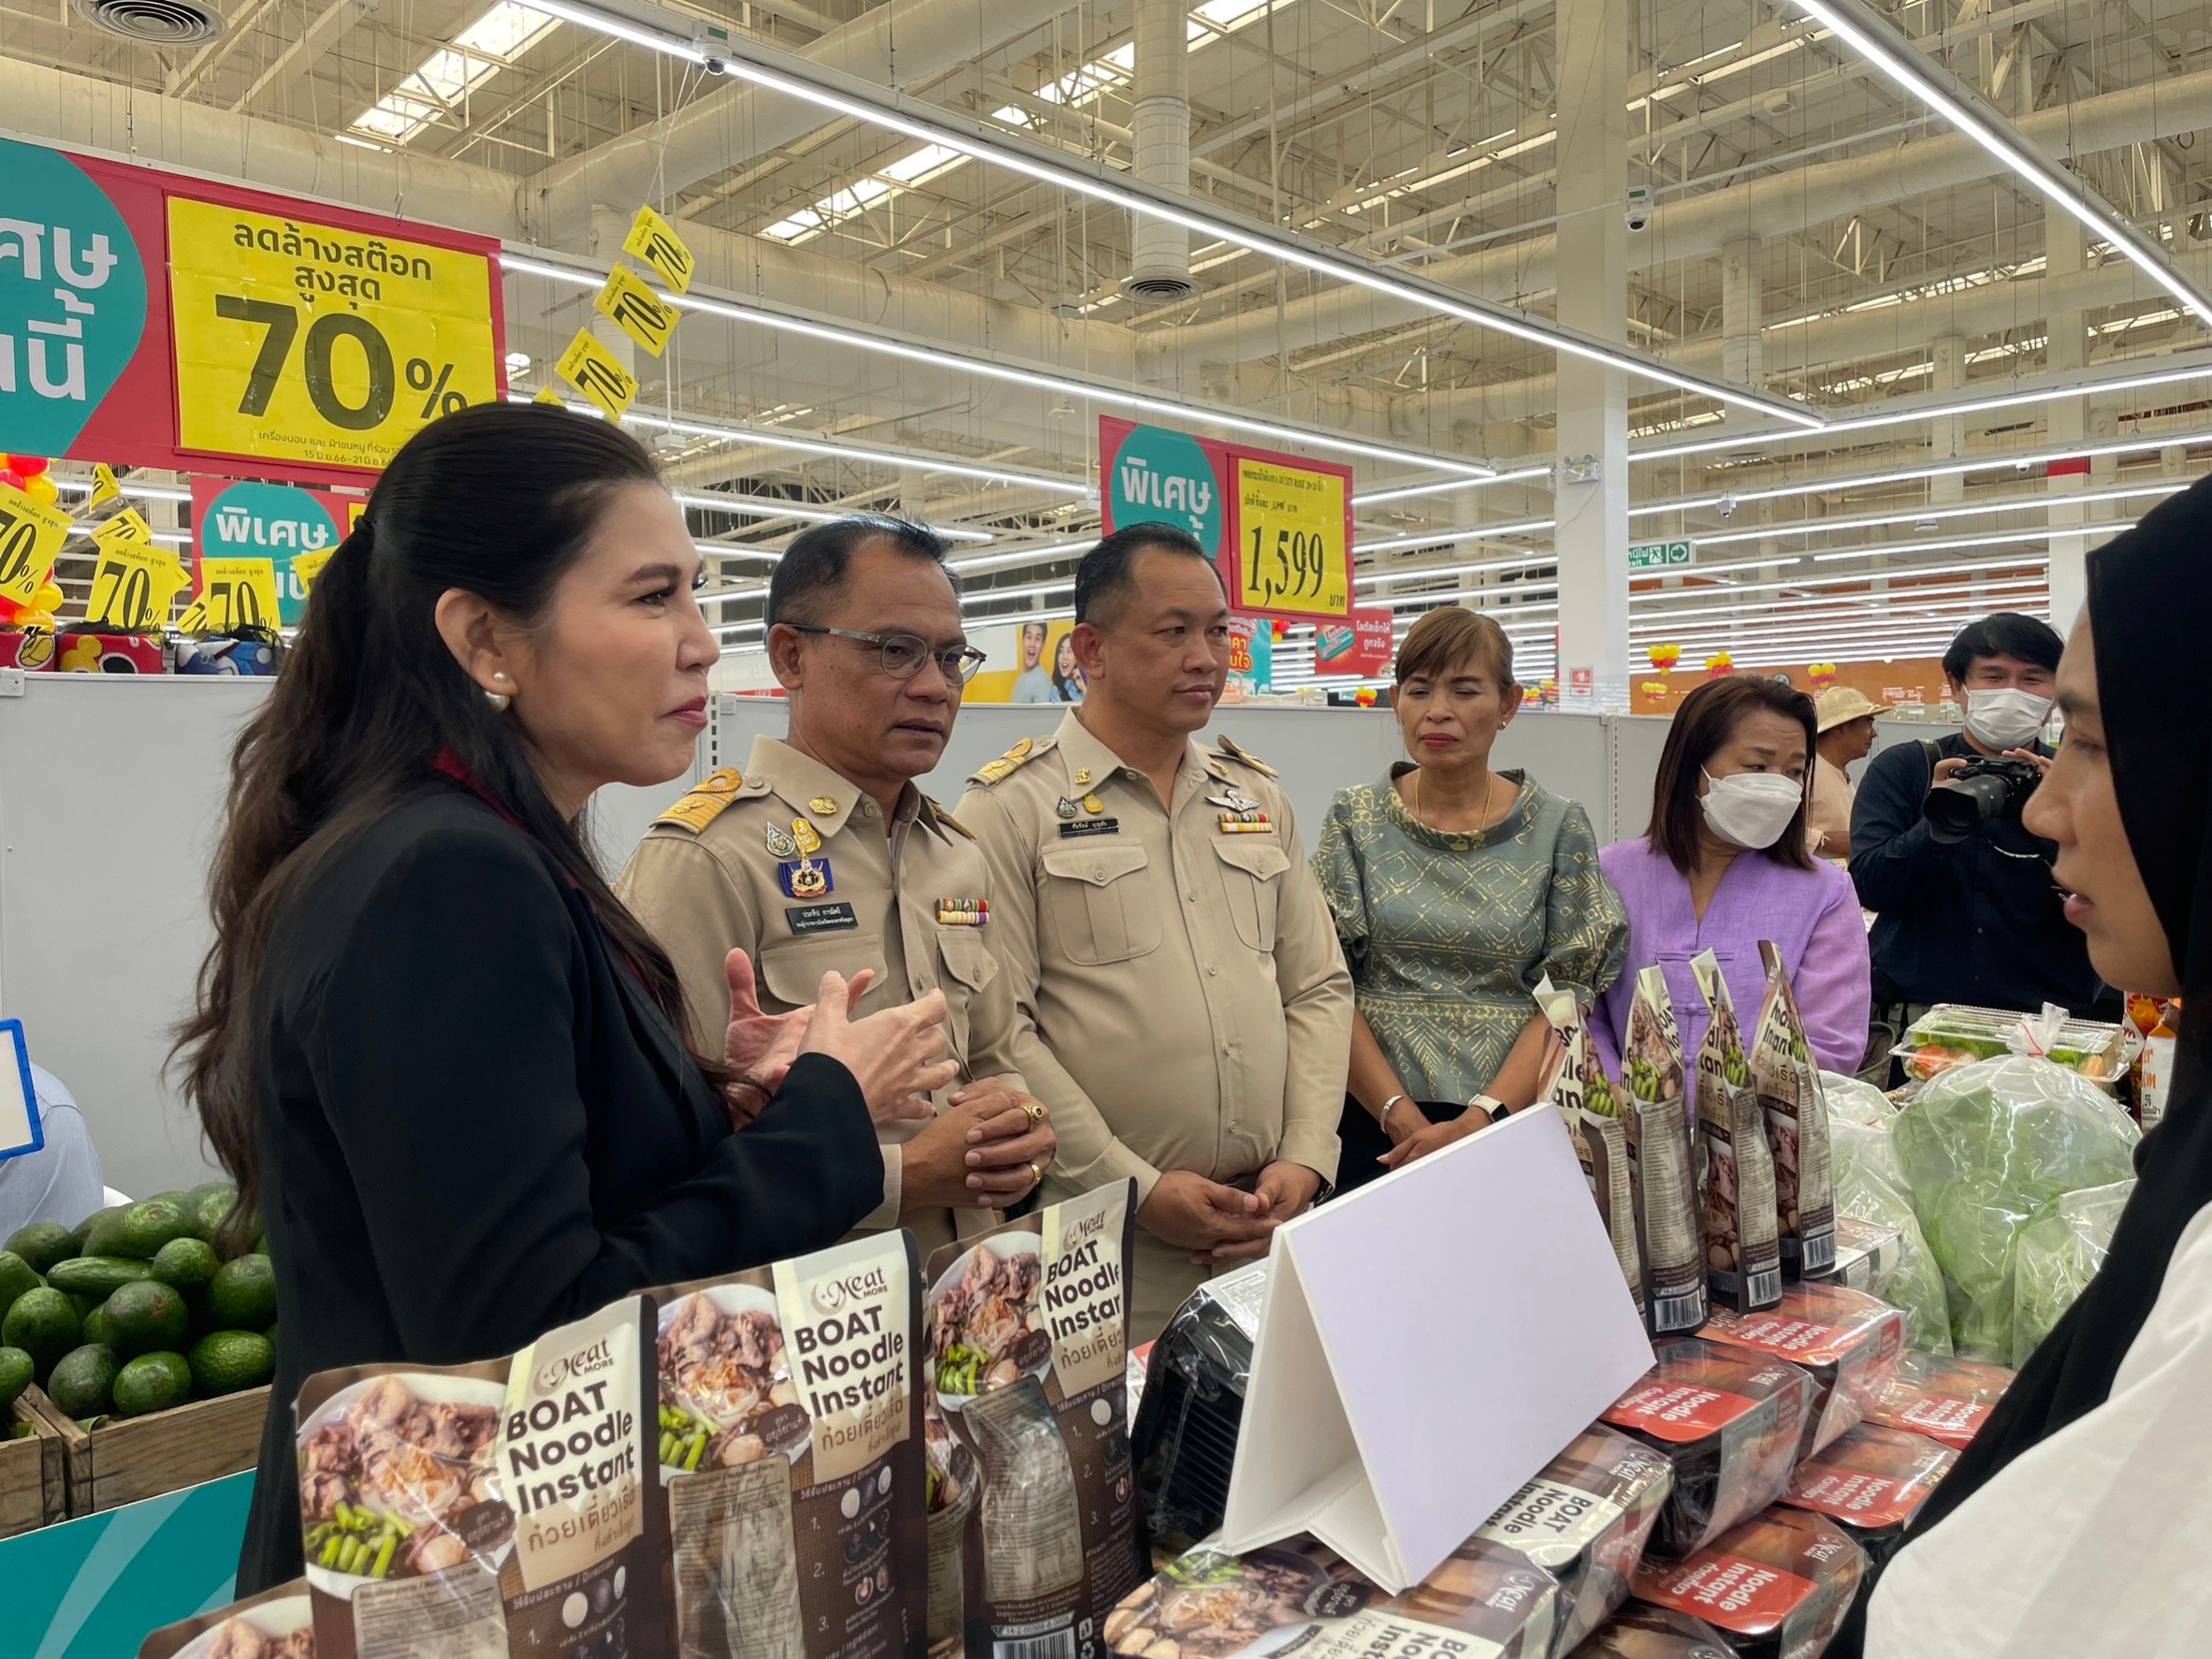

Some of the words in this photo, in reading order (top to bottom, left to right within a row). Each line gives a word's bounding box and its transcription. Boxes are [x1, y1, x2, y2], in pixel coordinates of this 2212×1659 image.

[234, 222, 431, 281] ลดล้างสต๊อก
[295, 266, 381, 310] สูงสุด
[1121, 457, 1212, 516] พิเศษ
[215, 506, 329, 550] พิเศษ
[1247, 526, 1324, 606] 1,599
[1047, 1239, 1099, 1286] BOAT
[827, 1266, 886, 1306] Meat
[863, 1285, 889, 1298] MORE
[794, 1304, 882, 1355] BOAT
[550, 1337, 611, 1386] Meat
[584, 1358, 615, 1375] MORE
[802, 1332, 903, 1386] Noodle
[809, 1359, 903, 1418] Instant
[1636, 1387, 1698, 1415] Instant
[1660, 1391, 1721, 1420] Noodle
[506, 1380, 608, 1442] BOAT
[509, 1410, 633, 1477] Noodle
[517, 1442, 634, 1515] Instant
[1822, 1475, 1870, 1506] Instant
[1846, 1478, 1893, 1510] Noodle
[1504, 1488, 1569, 1534] Noodle
[1543, 1495, 1594, 1534] BOAT
[813, 1563, 824, 1578] 2.
[1693, 1563, 1754, 1605] Instant
[1719, 1569, 1779, 1611] Noodle
[1498, 1575, 1535, 1612] Meat
[819, 1616, 829, 1632] 3.
